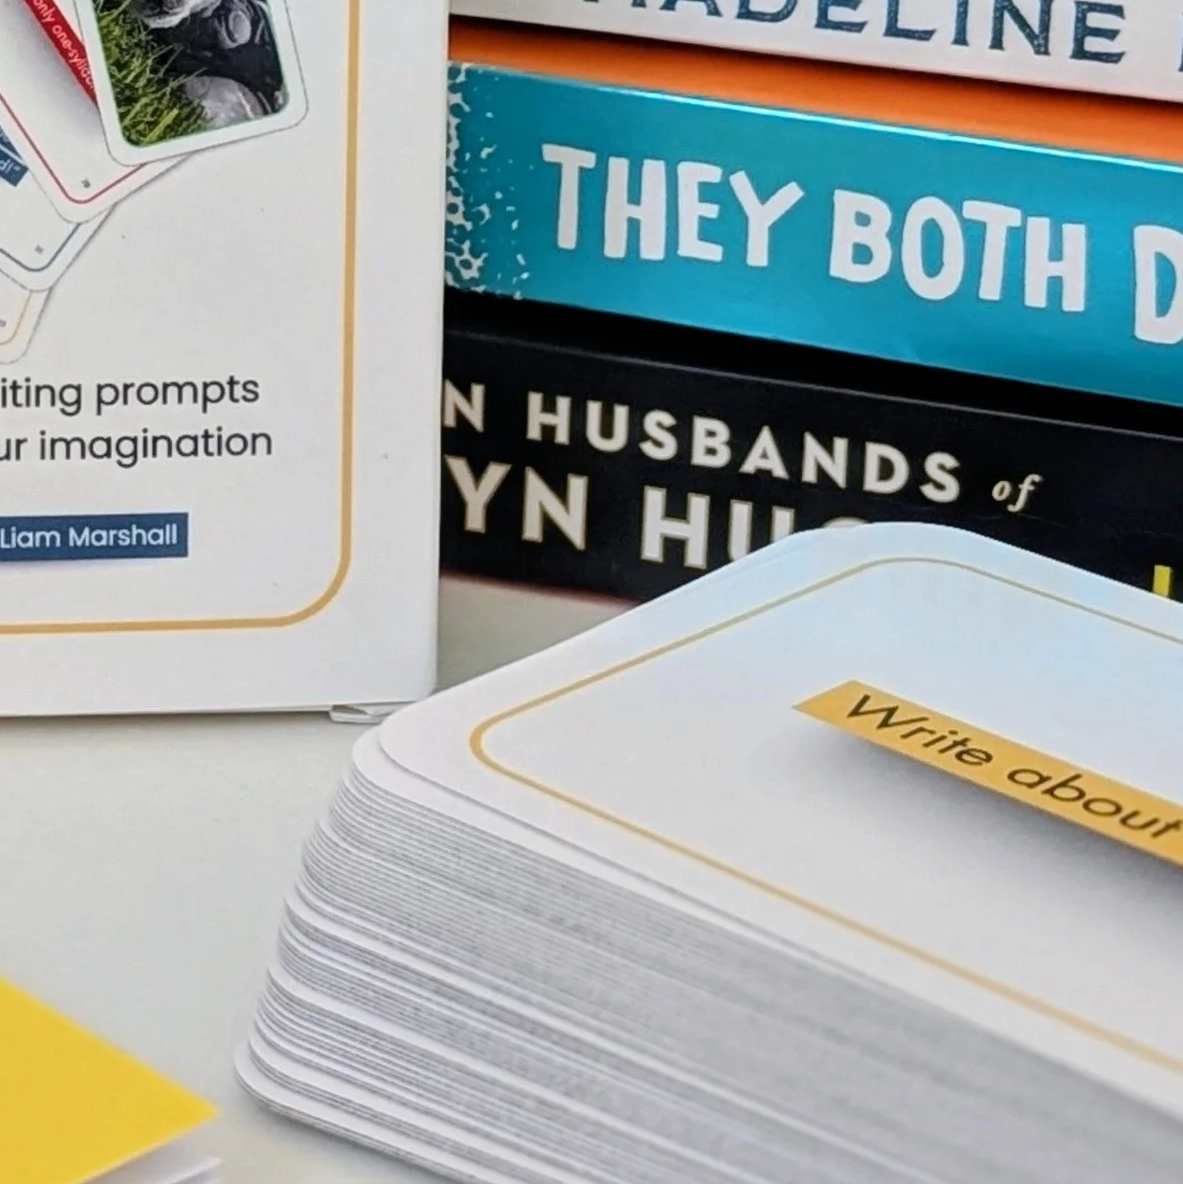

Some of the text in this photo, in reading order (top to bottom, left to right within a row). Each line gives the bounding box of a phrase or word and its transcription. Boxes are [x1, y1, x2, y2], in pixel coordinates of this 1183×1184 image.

[541, 143, 804, 268] THEY
[829, 189, 1087, 313] BOTH
[96, 374, 260, 416] prompts
[39, 426, 274, 468] imagination
[526, 390, 962, 504] HUSBANDS
[991, 473, 1042, 512] of
[0, 526, 62, 549] Liam
[68, 523, 178, 548] Marshall
[640, 485, 870, 571] HU
[846, 696, 1183, 839] Write about
